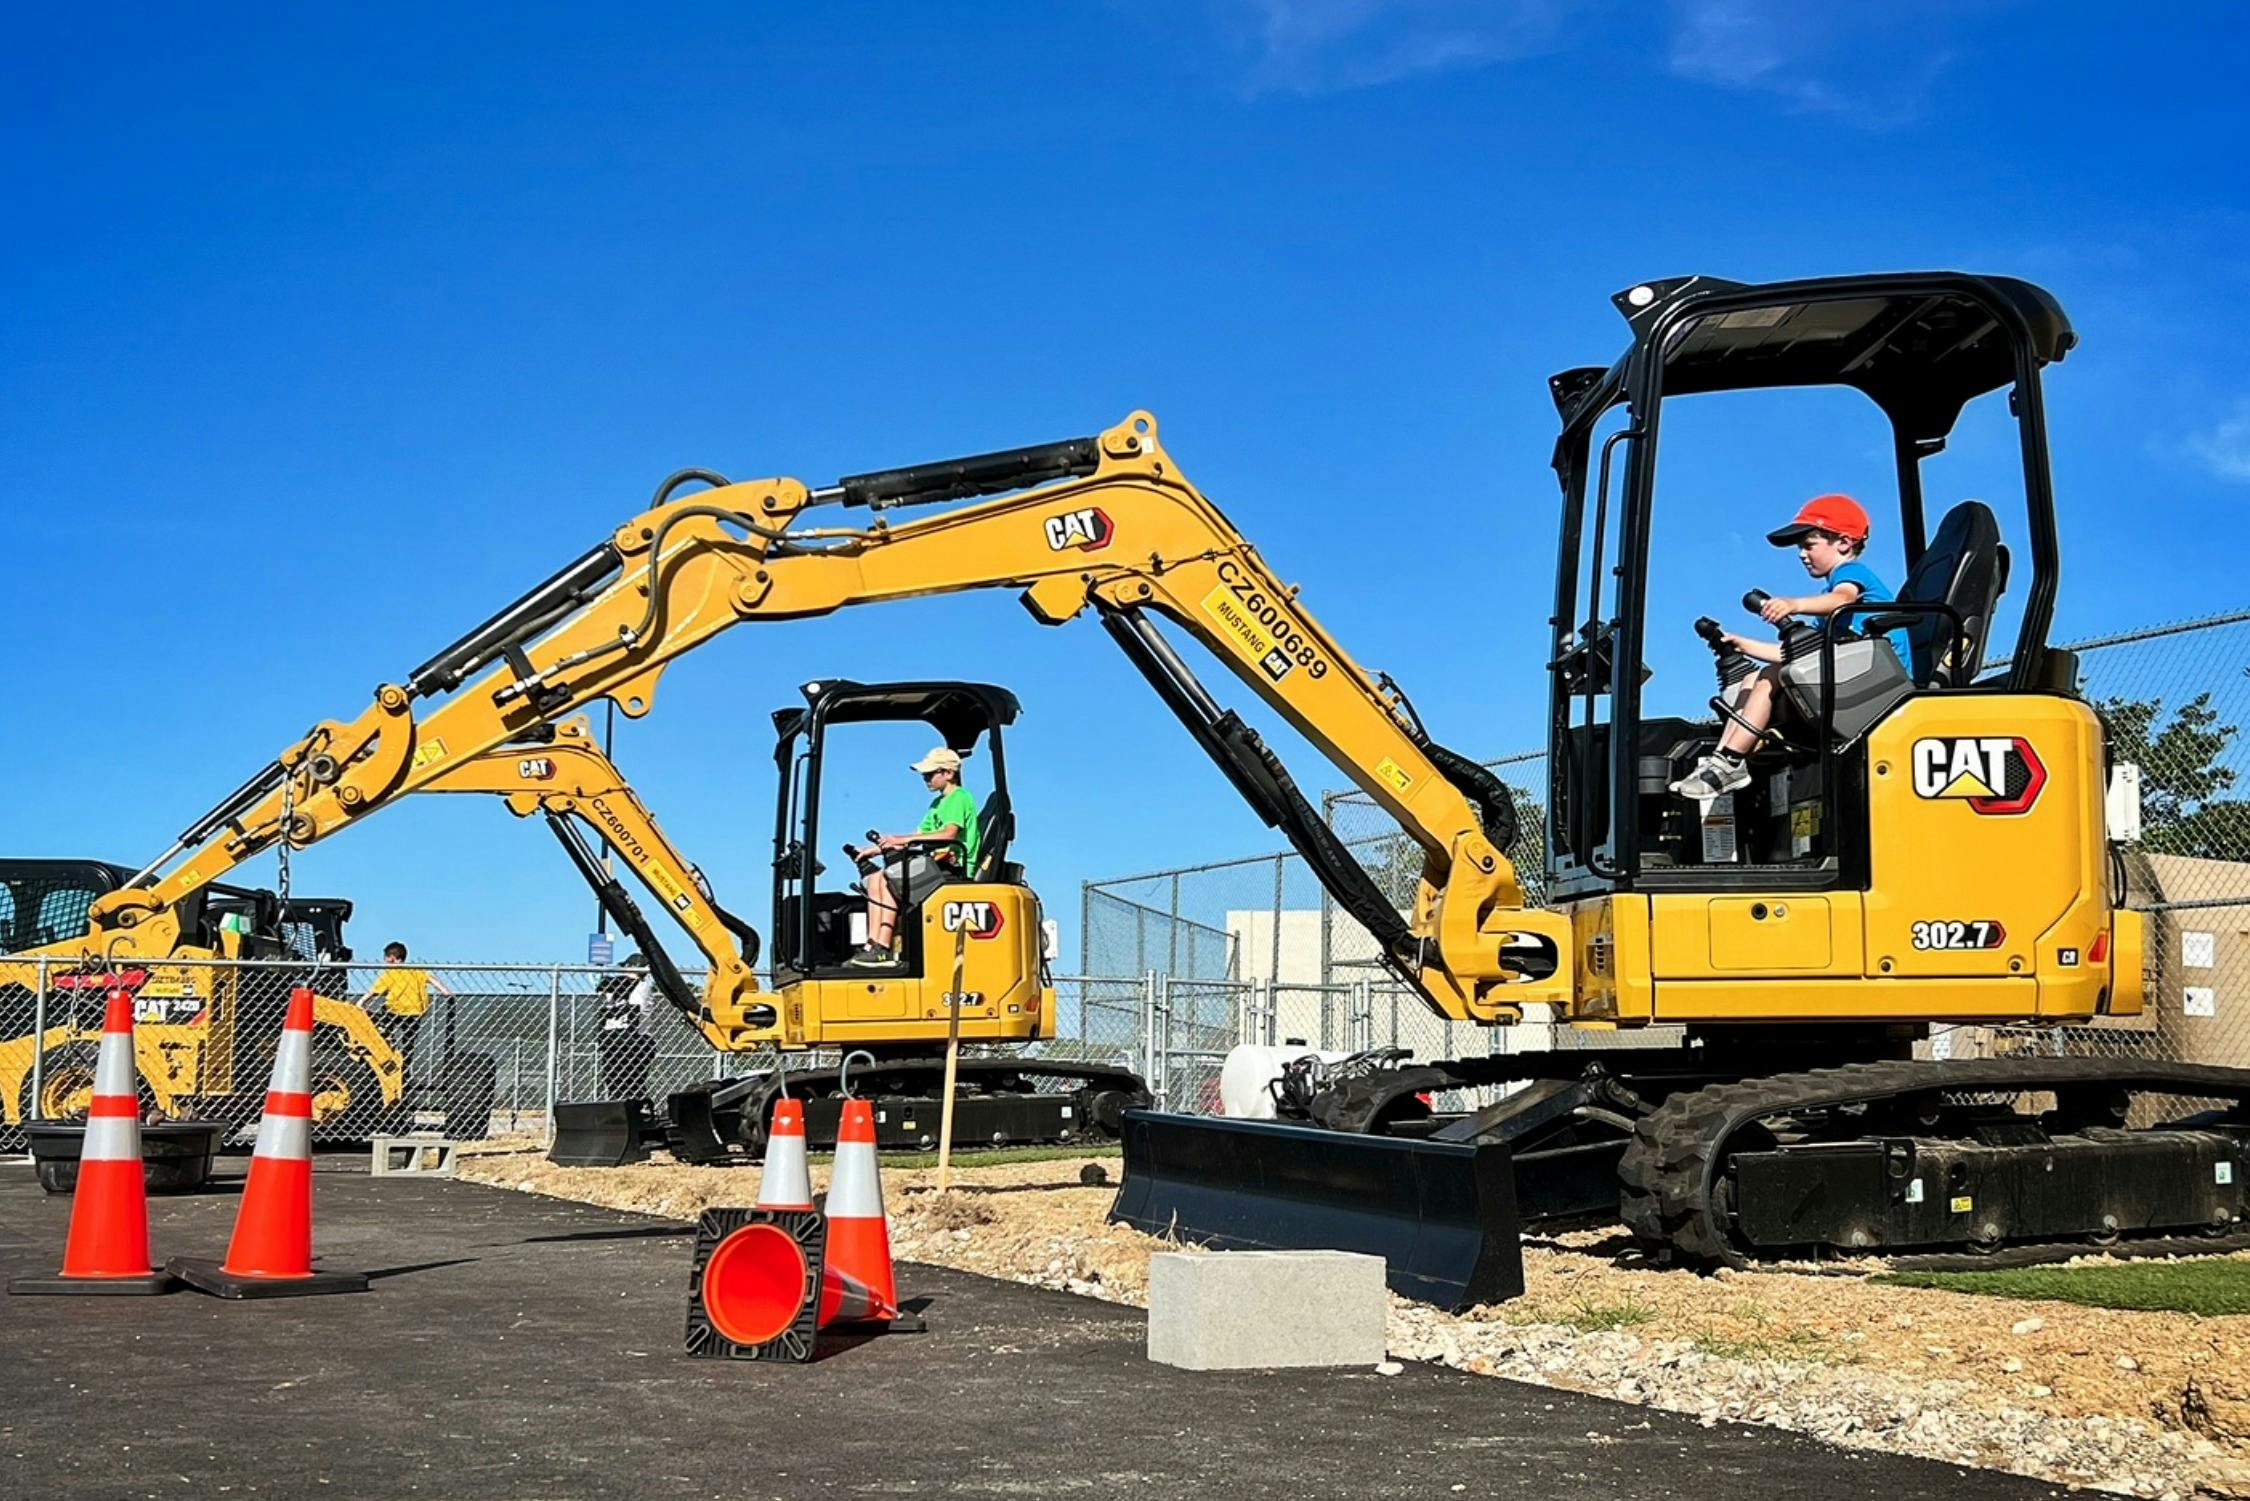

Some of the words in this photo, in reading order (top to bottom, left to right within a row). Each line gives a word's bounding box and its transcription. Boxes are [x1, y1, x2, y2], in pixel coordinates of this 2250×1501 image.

[1045, 508, 1096, 550] CAT
[1217, 561, 1328, 680] CZ600689
[1217, 601, 1266, 653] MUSTANG
[1264, 652, 1289, 676] CAT
[519, 759, 548, 778] CAT
[1914, 739, 2013, 797] CAT
[592, 798, 649, 864] CZ600701
[944, 902, 990, 931] CAT
[1913, 921, 1990, 949] 302.7
[134, 999, 170, 1021] CAT
[943, 992, 979, 1006] 32.7
